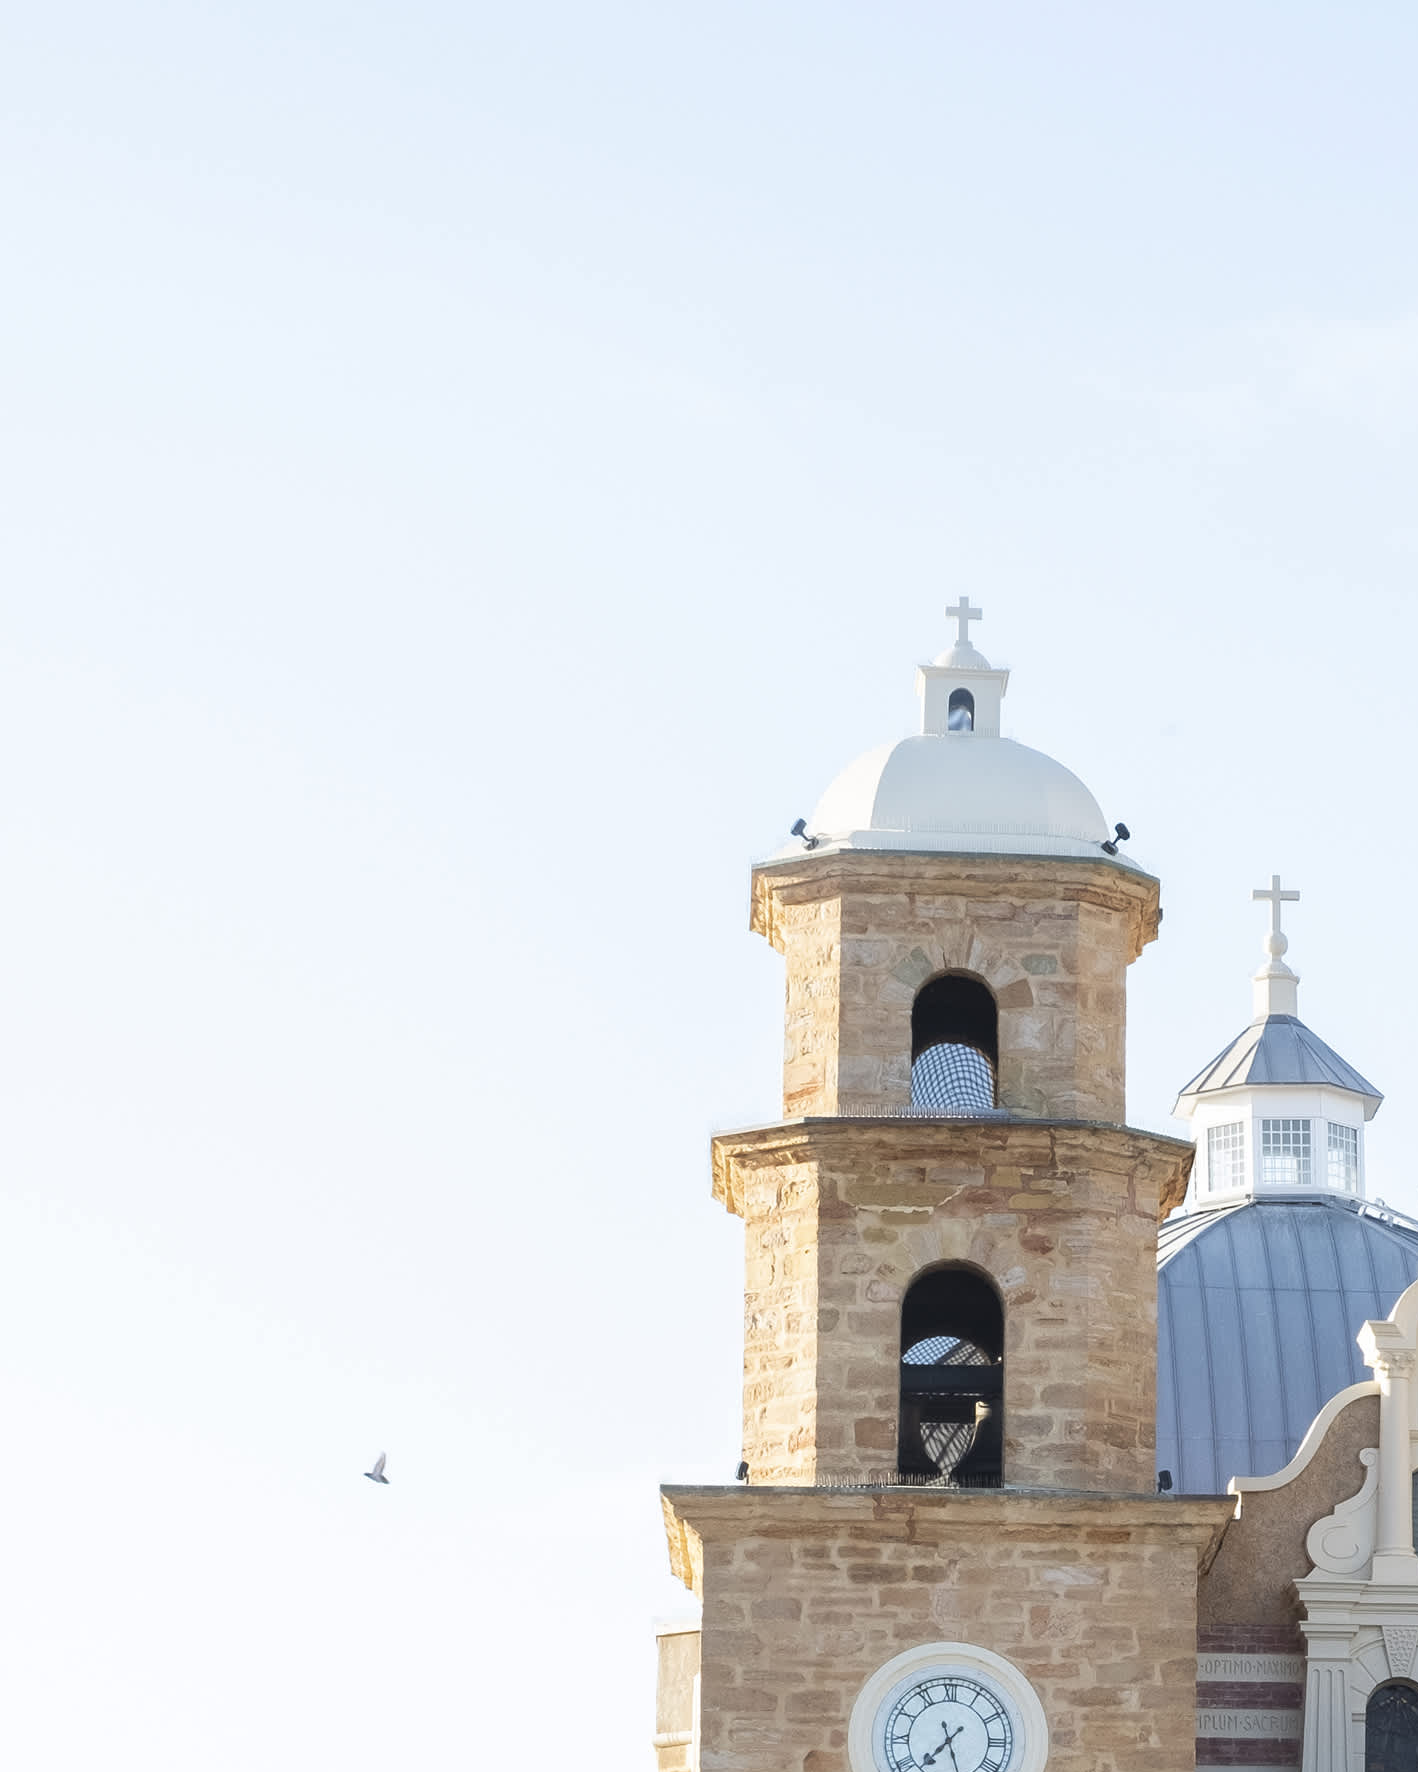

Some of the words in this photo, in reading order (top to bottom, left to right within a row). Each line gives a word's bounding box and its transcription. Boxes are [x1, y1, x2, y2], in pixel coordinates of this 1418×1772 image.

[917, 1688, 935, 1708] XI
[944, 1684, 957, 1702] XII
[988, 1738, 1006, 1747] III
